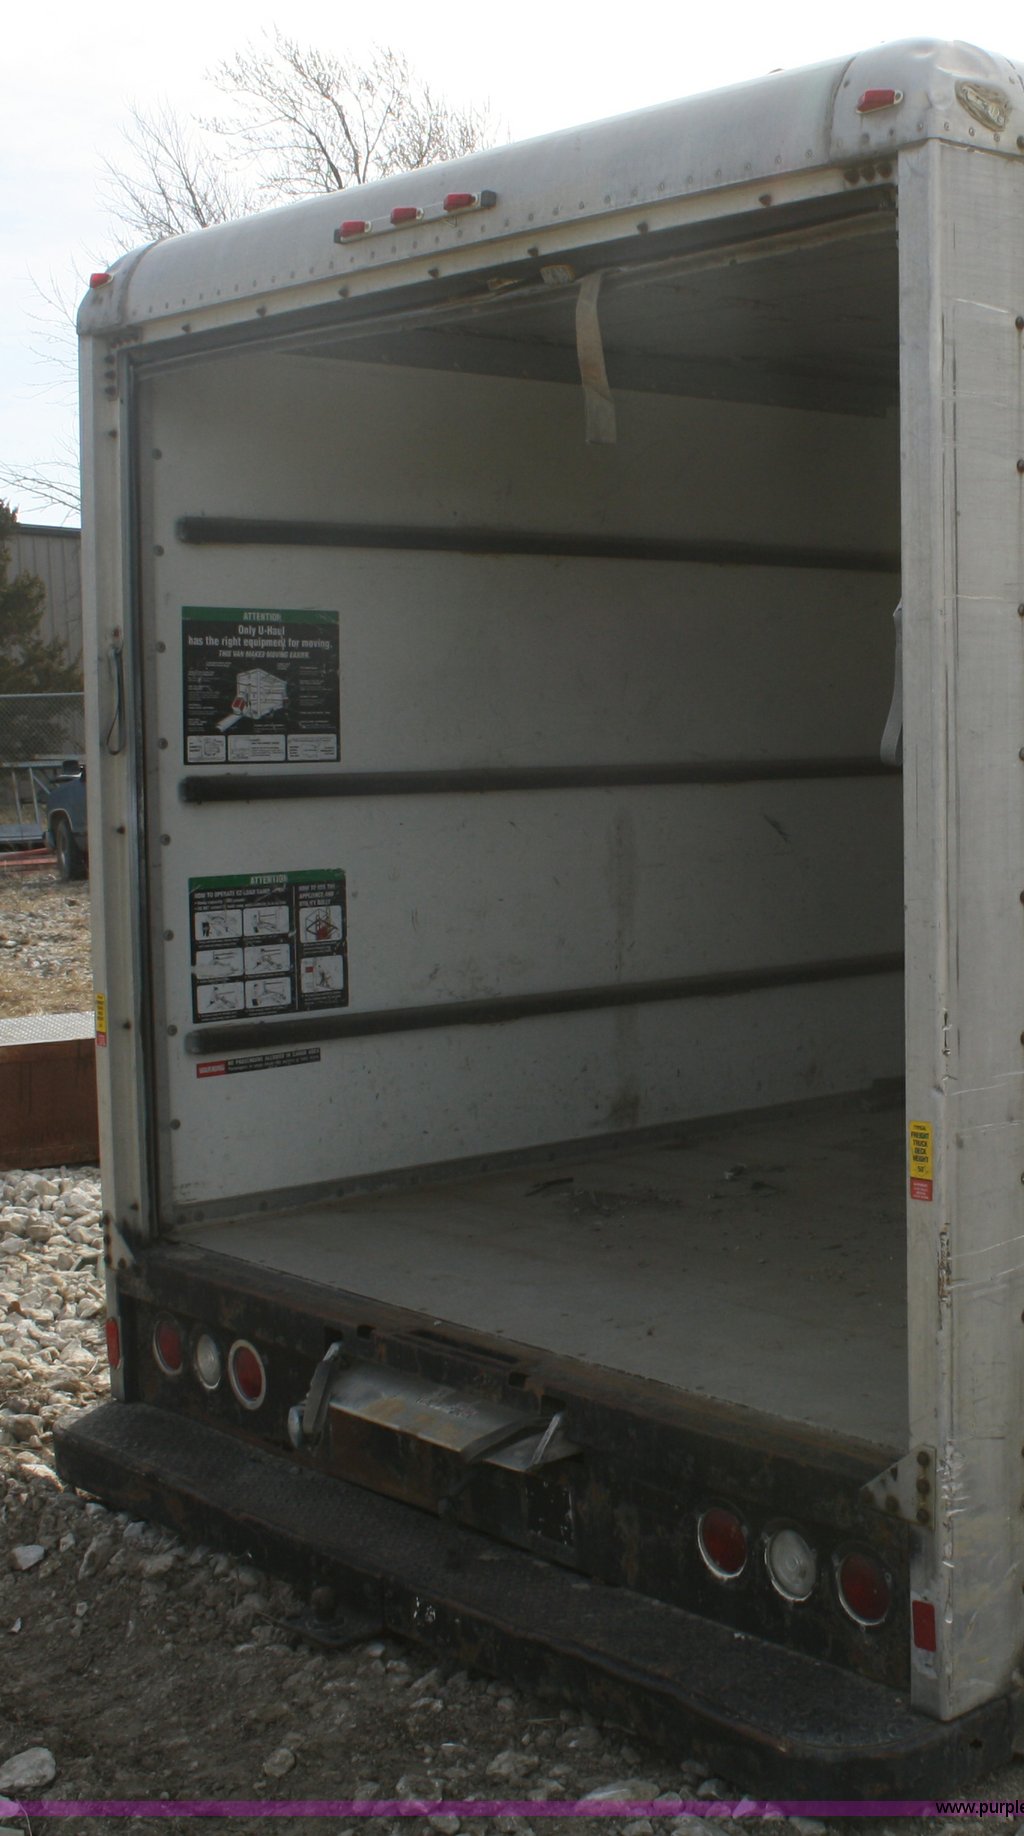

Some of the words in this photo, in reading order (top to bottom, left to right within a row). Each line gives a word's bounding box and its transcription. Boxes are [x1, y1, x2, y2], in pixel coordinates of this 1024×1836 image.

[238, 625, 256, 636] Only
[258, 626, 285, 636] U-Haul
[188, 636, 203, 646] has
[205, 636, 219, 646] the
[221, 636, 241, 648] right
[288, 638, 299, 648] for
[913, 1139, 928, 1147] TRUCK
